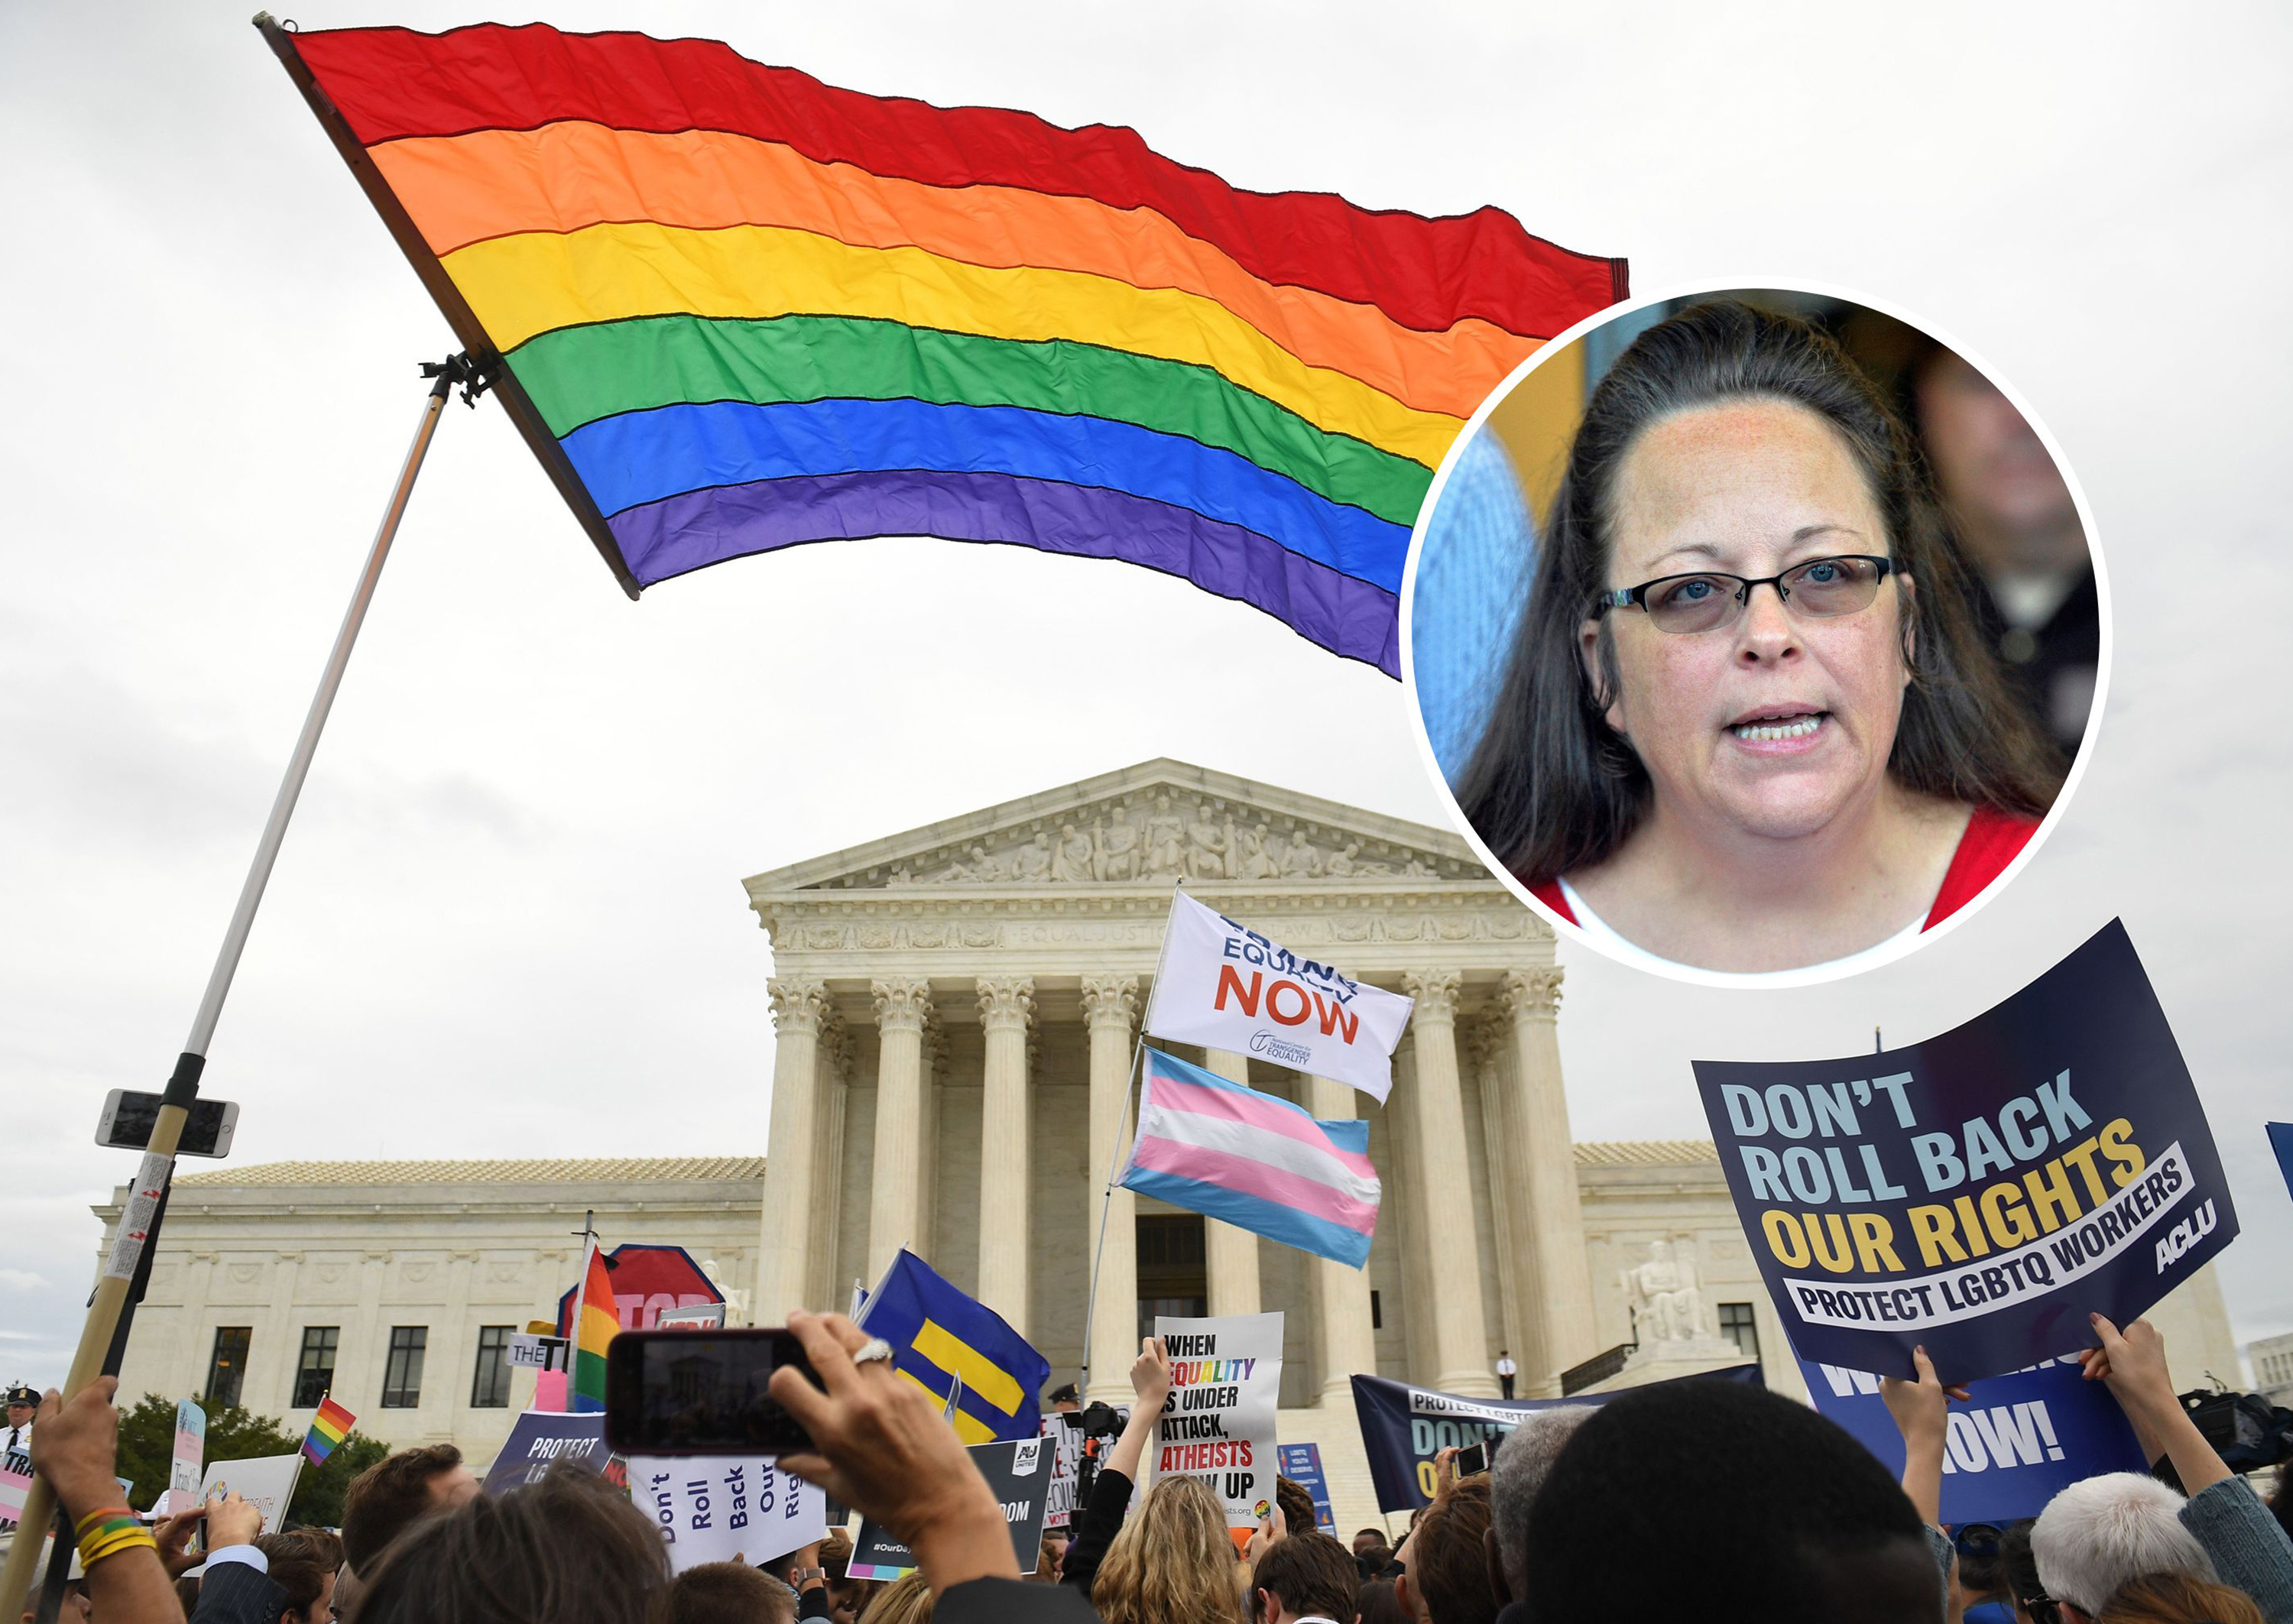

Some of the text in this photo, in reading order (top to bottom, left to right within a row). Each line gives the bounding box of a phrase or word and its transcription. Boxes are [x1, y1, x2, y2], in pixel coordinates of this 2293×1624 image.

[1020, 925, 1167, 943] EQUAL JUSTIC
[1214, 964, 1359, 1045] NOW
[1267, 1048, 1309, 1065] EQUALITY
[1270, 1042, 1311, 1058] TRANSGENDER
[1739, 1068, 2094, 1204] ROLL BACK
[1761, 1117, 2146, 1273] OUR RIGHTS
[1796, 1158, 2183, 1321] PROTECT LGBTQ WORKERS
[2154, 1198, 2217, 1276] ACLU
[514, 1338, 570, 1374] THE T
[1164, 1334, 1216, 1357] WHEN
[1182, 1386, 1238, 1412] UNDER
[1161, 1414, 1228, 1441] ATTACK,
[1941, 1400, 2065, 1475] OW!
[5, 1451, 35, 1479] TRA
[527, 1438, 599, 1459] PROTECT
[1159, 1440, 1253, 1471] ATHEISTS
[725, 1464, 748, 1529] Back
[760, 1464, 774, 1512] Our
[785, 1471, 803, 1519] Rig
[1225, 1473, 1254, 1499] UP
[687, 1480, 712, 1530] Roll
